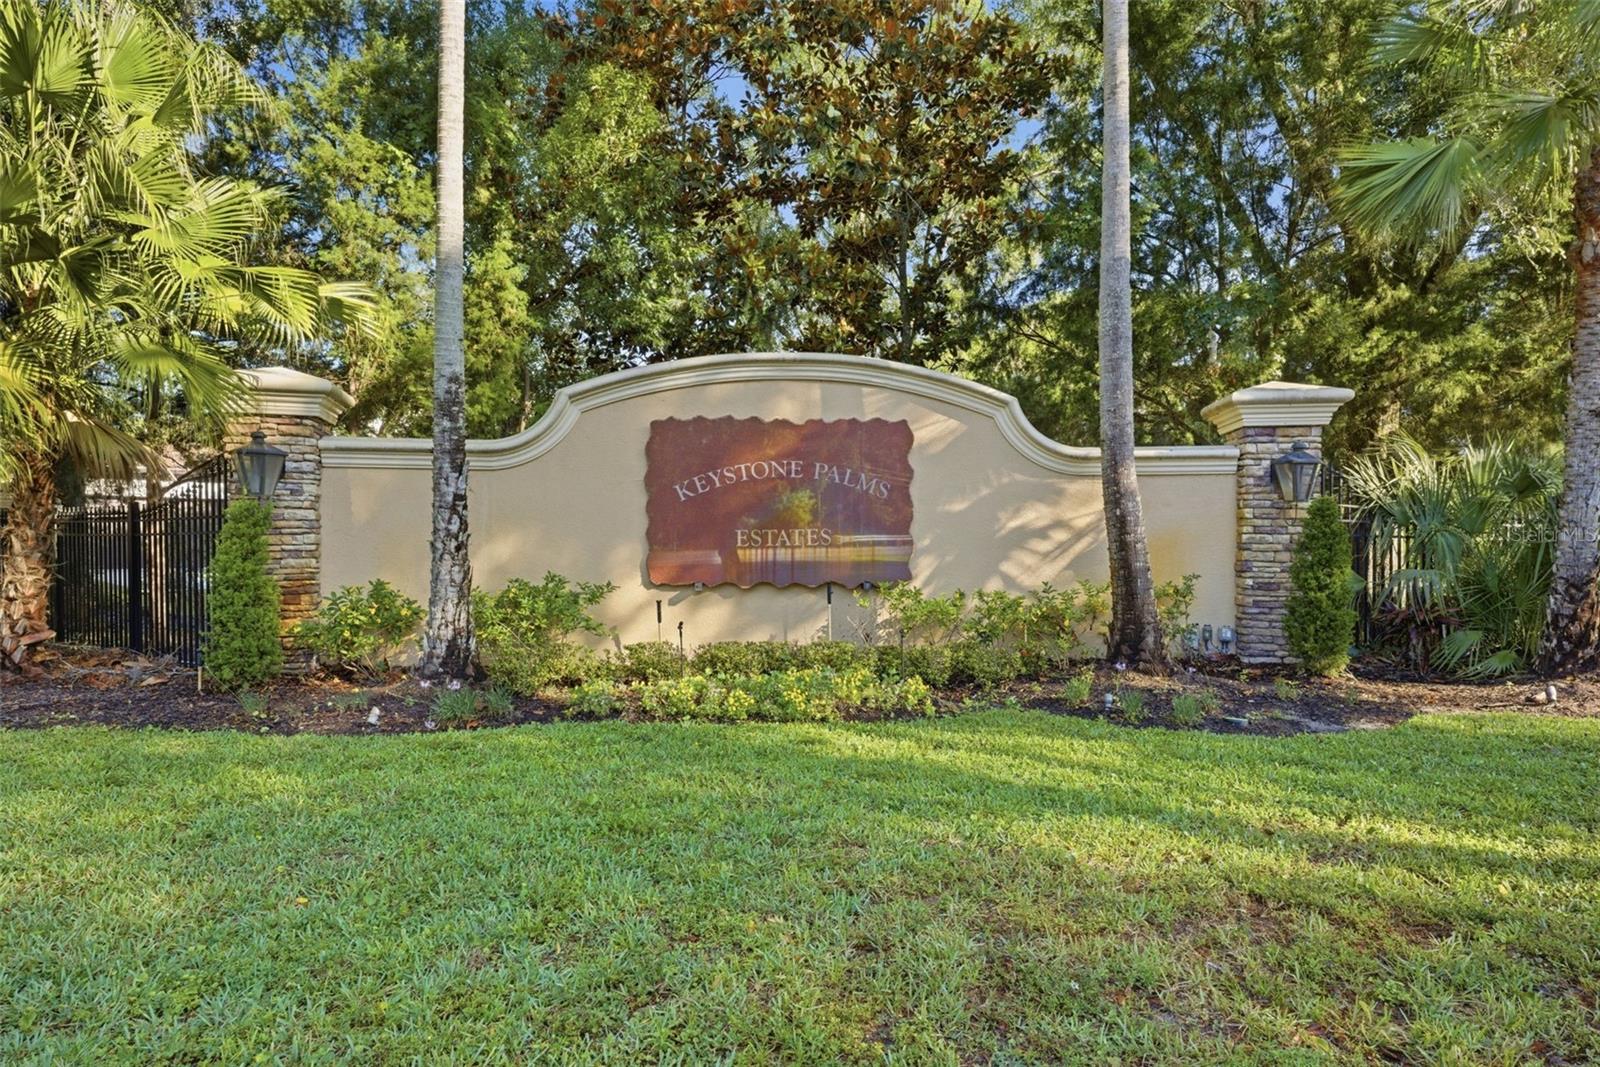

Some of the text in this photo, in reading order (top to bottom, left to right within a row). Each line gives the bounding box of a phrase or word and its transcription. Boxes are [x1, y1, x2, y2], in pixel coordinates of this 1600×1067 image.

[674, 460, 891, 502] KEYSTONE PALMS
[735, 528, 832, 548] ESTATES
